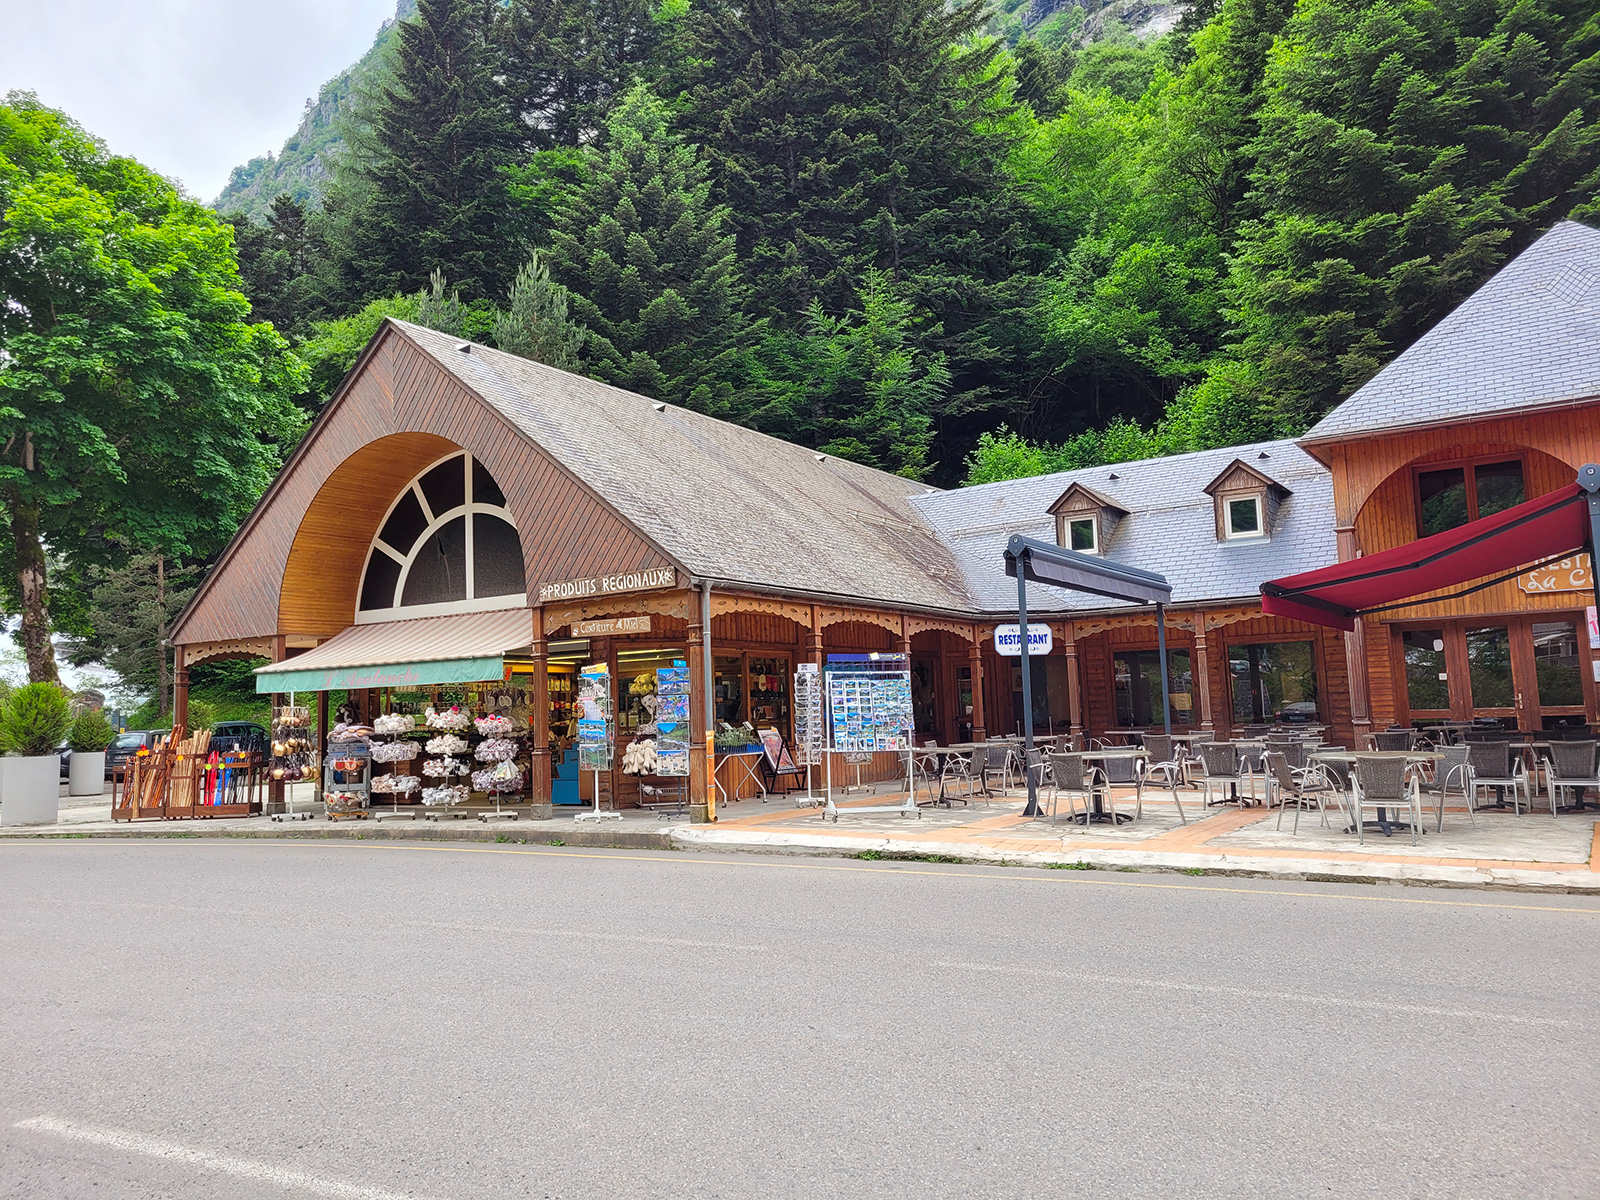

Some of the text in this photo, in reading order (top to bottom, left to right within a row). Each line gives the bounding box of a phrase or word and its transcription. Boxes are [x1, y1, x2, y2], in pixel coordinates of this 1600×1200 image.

[547, 570, 664, 598] PRODUITS REGIONAUX
[1569, 569, 1594, 587] C
[998, 634, 1048, 645] RESTARANT
